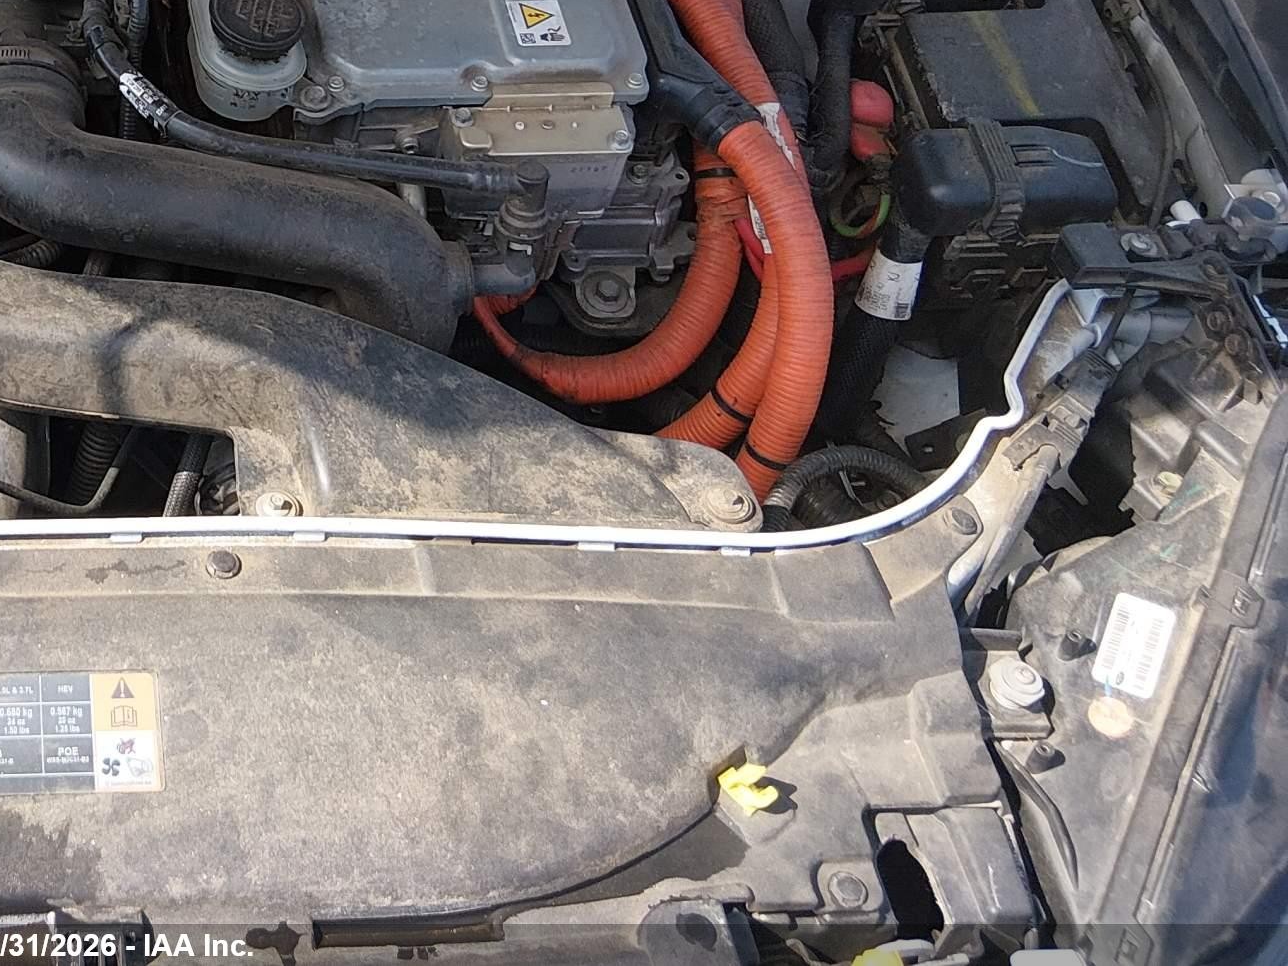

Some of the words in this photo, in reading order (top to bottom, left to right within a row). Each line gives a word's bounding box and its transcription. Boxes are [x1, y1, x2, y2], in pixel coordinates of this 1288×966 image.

[12, 686, 17, 694] &
[57, 684, 73, 693] HEV
[22, 707, 33, 719] kg
[72, 706, 83, 718] kg
[19, 726, 30, 734] lbs
[69, 724, 81, 733] lbs
[57, 746, 79, 756] POE
